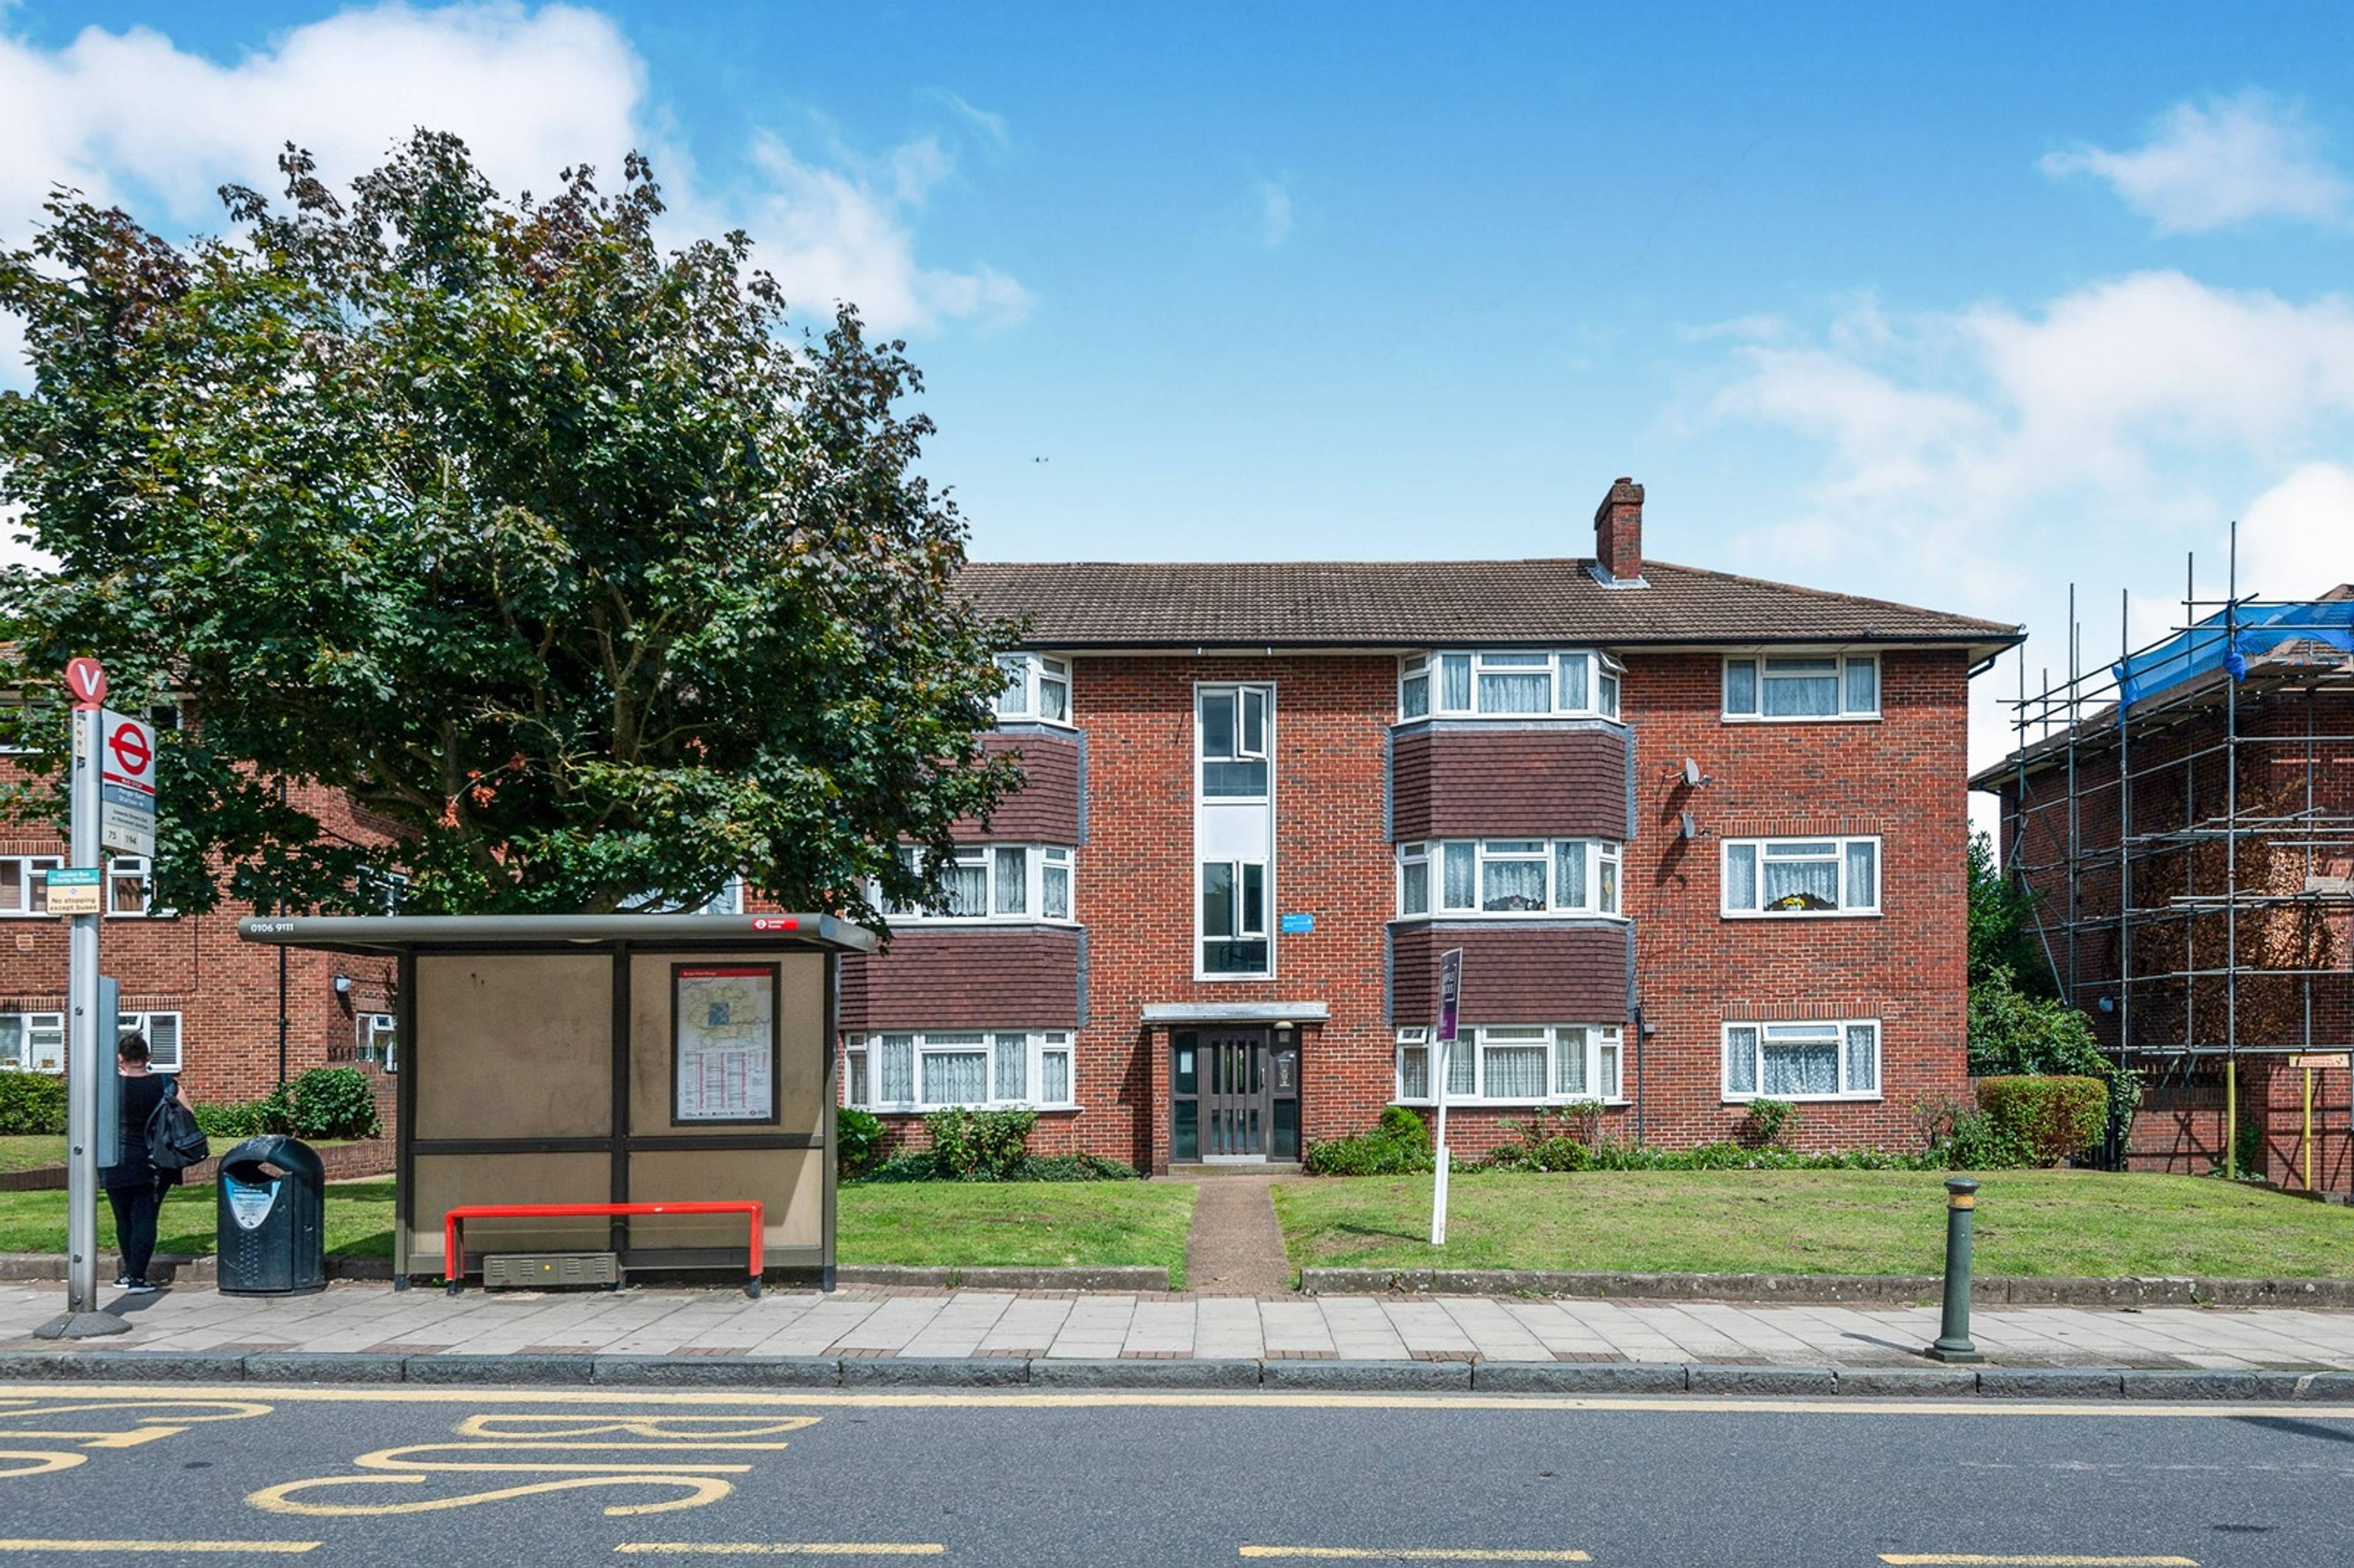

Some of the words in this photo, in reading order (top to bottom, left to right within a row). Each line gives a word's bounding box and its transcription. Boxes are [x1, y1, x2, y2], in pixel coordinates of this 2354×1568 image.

[78, 663, 101, 696] V
[109, 830, 117, 840] 75
[125, 835, 137, 845] 194
[251, 923, 273, 932] 0106
[275, 923, 294, 932] 9111
[245, 1414, 825, 1517] BUS
